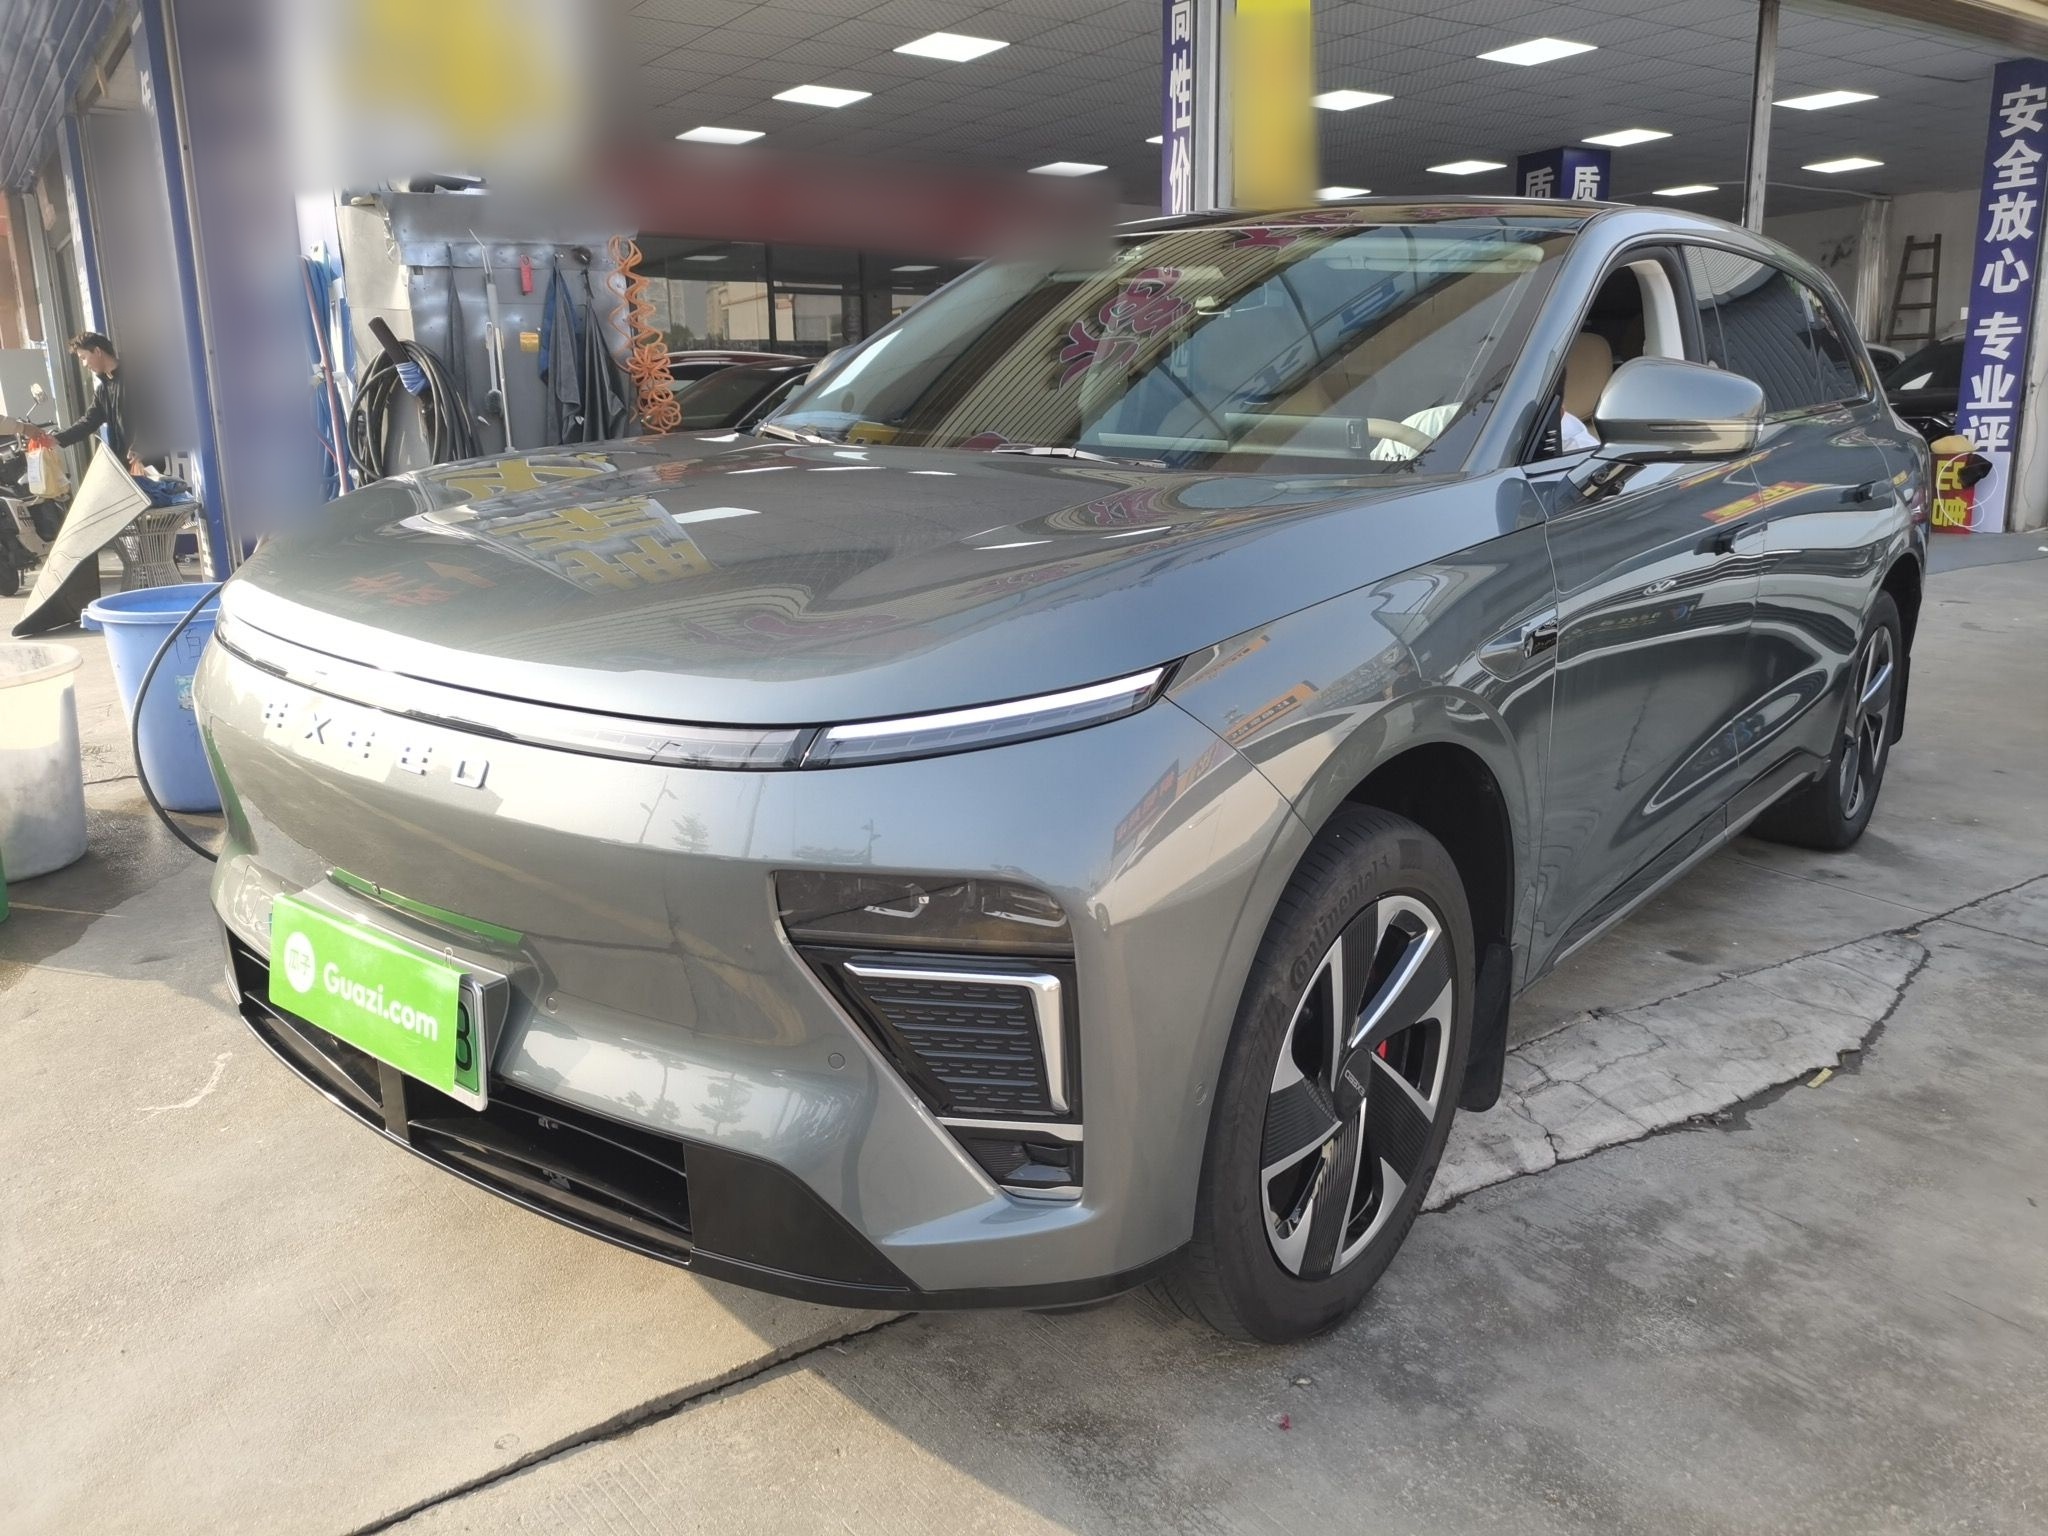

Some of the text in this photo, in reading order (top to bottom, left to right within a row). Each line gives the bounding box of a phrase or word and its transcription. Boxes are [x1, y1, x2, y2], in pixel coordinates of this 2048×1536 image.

[1571, 165, 1601, 200] 质
[1979, 83, 2047, 294] 安全放心
[323, 961, 439, 1042] Guazi.com
